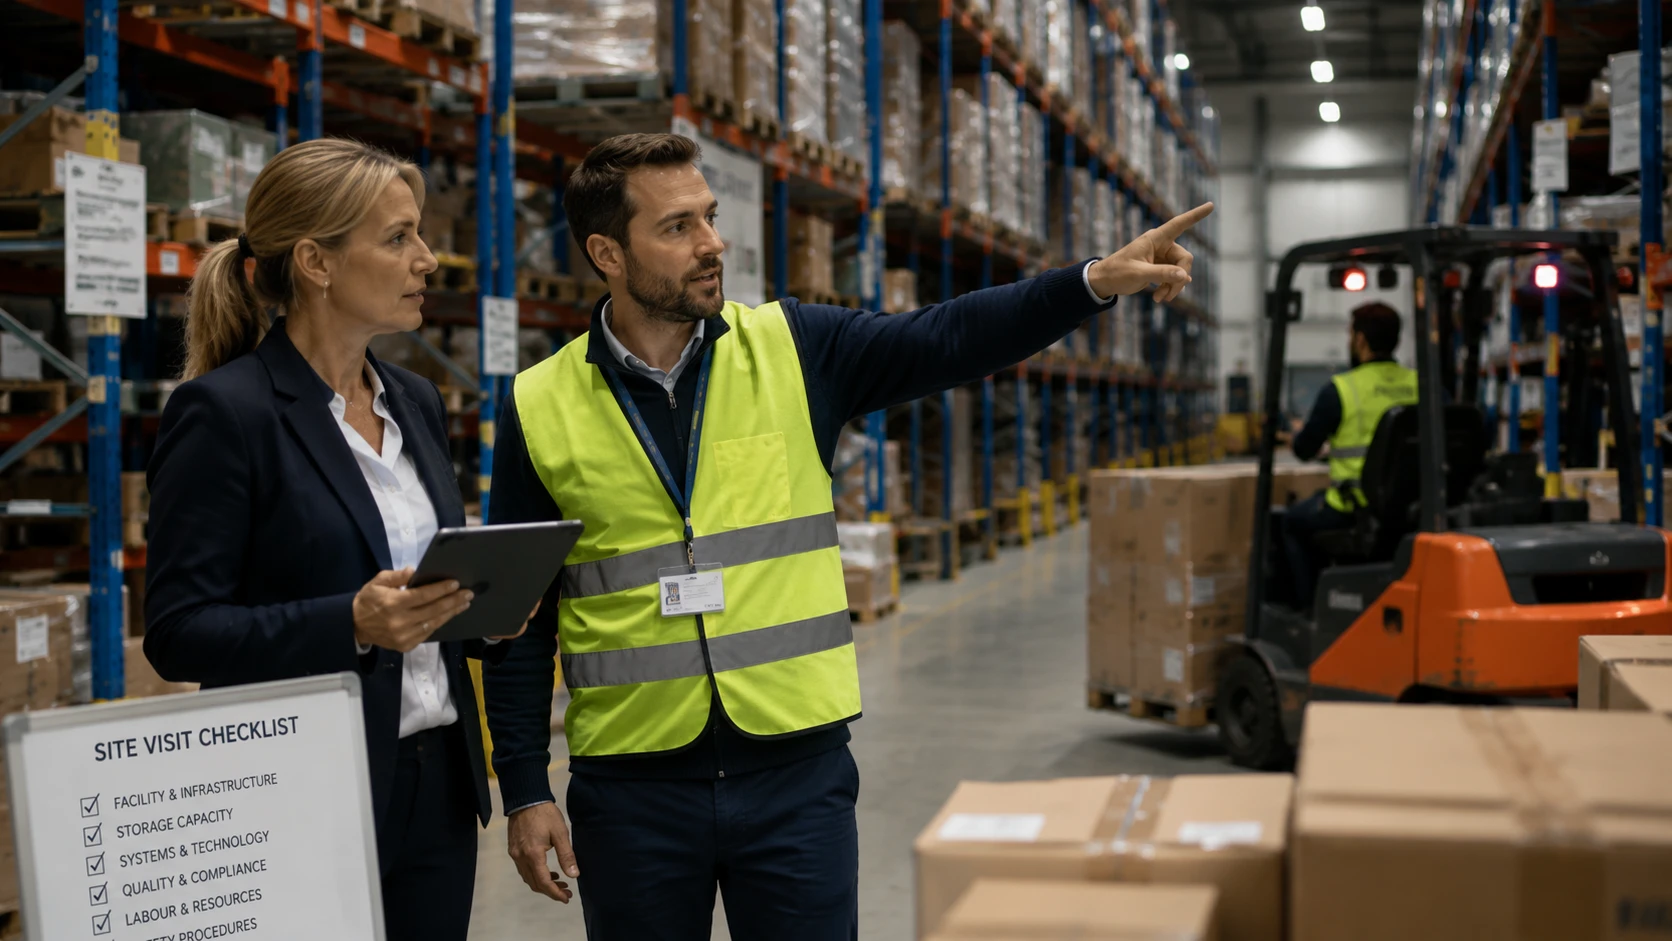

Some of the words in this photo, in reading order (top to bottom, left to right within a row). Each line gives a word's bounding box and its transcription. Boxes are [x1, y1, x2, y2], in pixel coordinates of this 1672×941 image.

[94, 738, 138, 762] SITE
[143, 730, 193, 755] VISIT
[199, 716, 298, 747] CHECKLIST
[114, 790, 165, 809] FACILITY
[169, 789, 177, 801] &
[181, 773, 278, 799] INFRASTRUCTURE
[117, 817, 174, 838] STORAGE
[177, 808, 233, 828] CAPACITY
[120, 847, 176, 868] SYSTEMS
[180, 845, 188, 857] &
[191, 830, 269, 855] TECHNOLOGY
[122, 876, 175, 897] QUALITY
[179, 874, 187, 886] &
[191, 859, 267, 884] COMPLIANCE
[125, 905, 177, 926] LABOUR
[181, 903, 190, 915] &
[193, 888, 262, 913] RESOURCES
[179, 918, 258, 941] PROCEDURES
